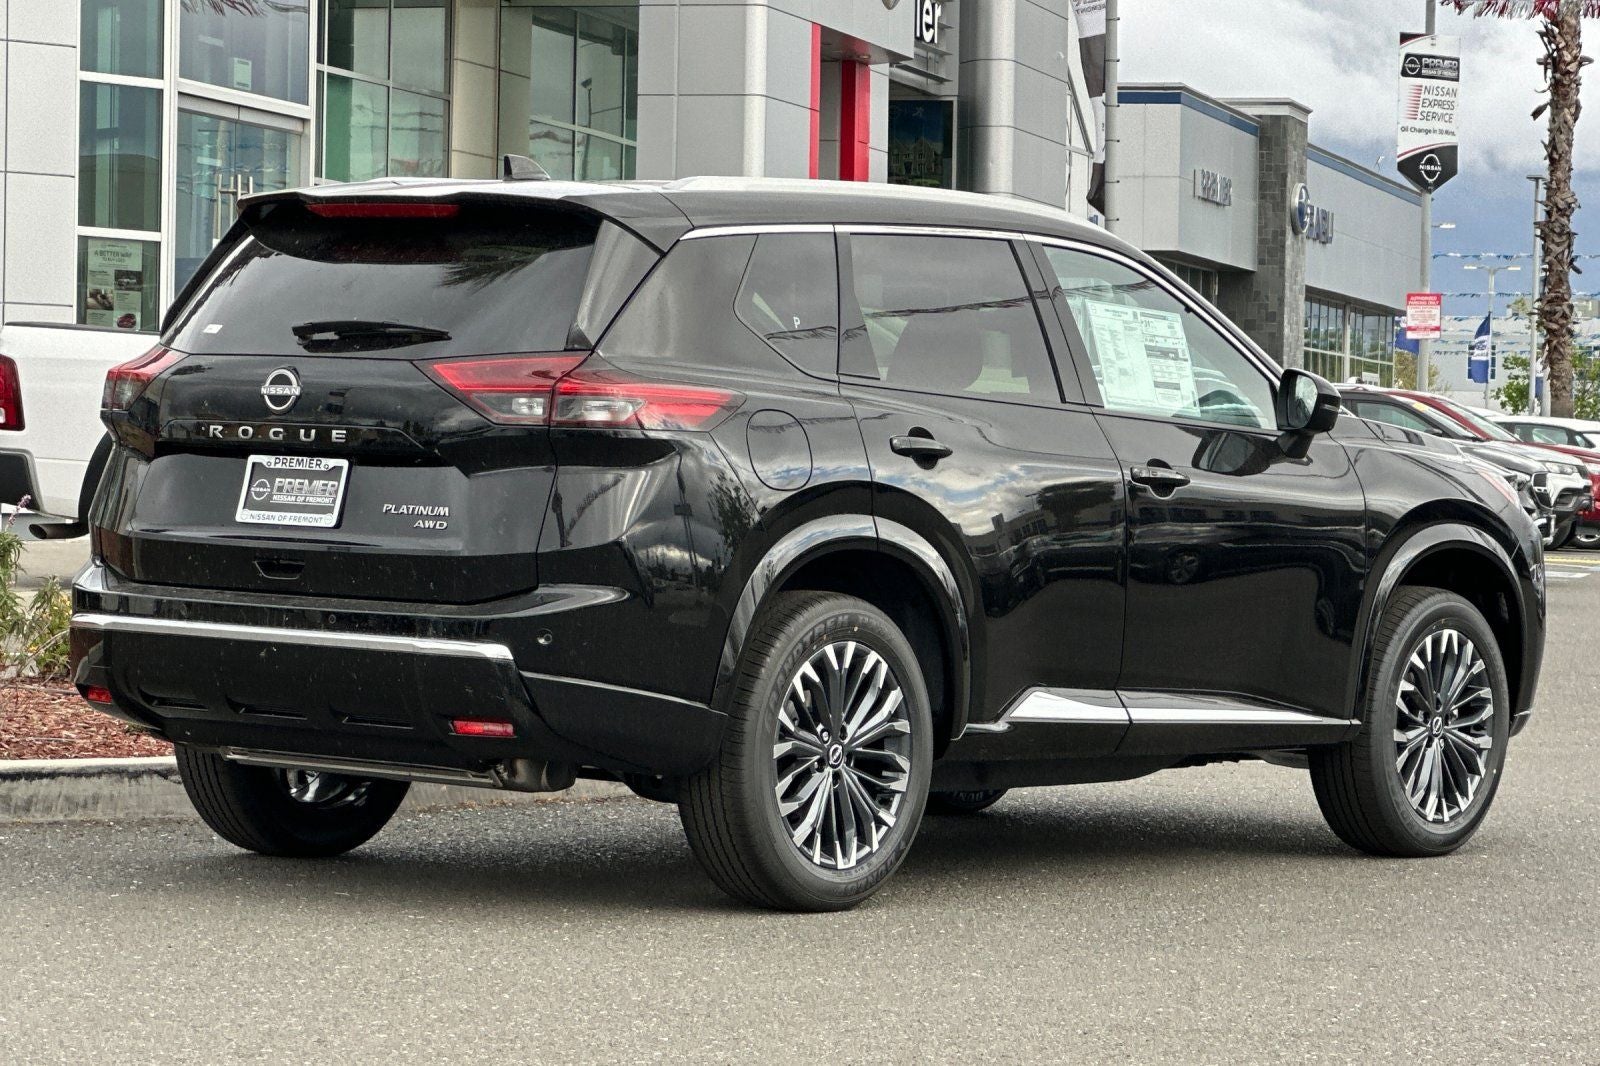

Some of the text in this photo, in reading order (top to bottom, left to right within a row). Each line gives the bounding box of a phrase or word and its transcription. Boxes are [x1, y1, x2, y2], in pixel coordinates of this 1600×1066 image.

[1424, 85, 1457, 98] NISSAN
[1421, 98, 1455, 110] EXPRESS
[1419, 110, 1454, 123] SERVICE
[1410, 126, 1432, 135] Change
[261, 386, 299, 395] NISSAN
[209, 424, 347, 443] ROGUE
[273, 456, 323, 470] PREMIER
[272, 477, 339, 498] PREMIER
[272, 494, 295, 502] NISSAN
[306, 496, 334, 504] FREMONT
[382, 503, 449, 517] PLATINUM
[249, 513, 275, 521] NISSAN
[288, 515, 323, 524] FREMONT
[413, 519, 448, 530] AWD
